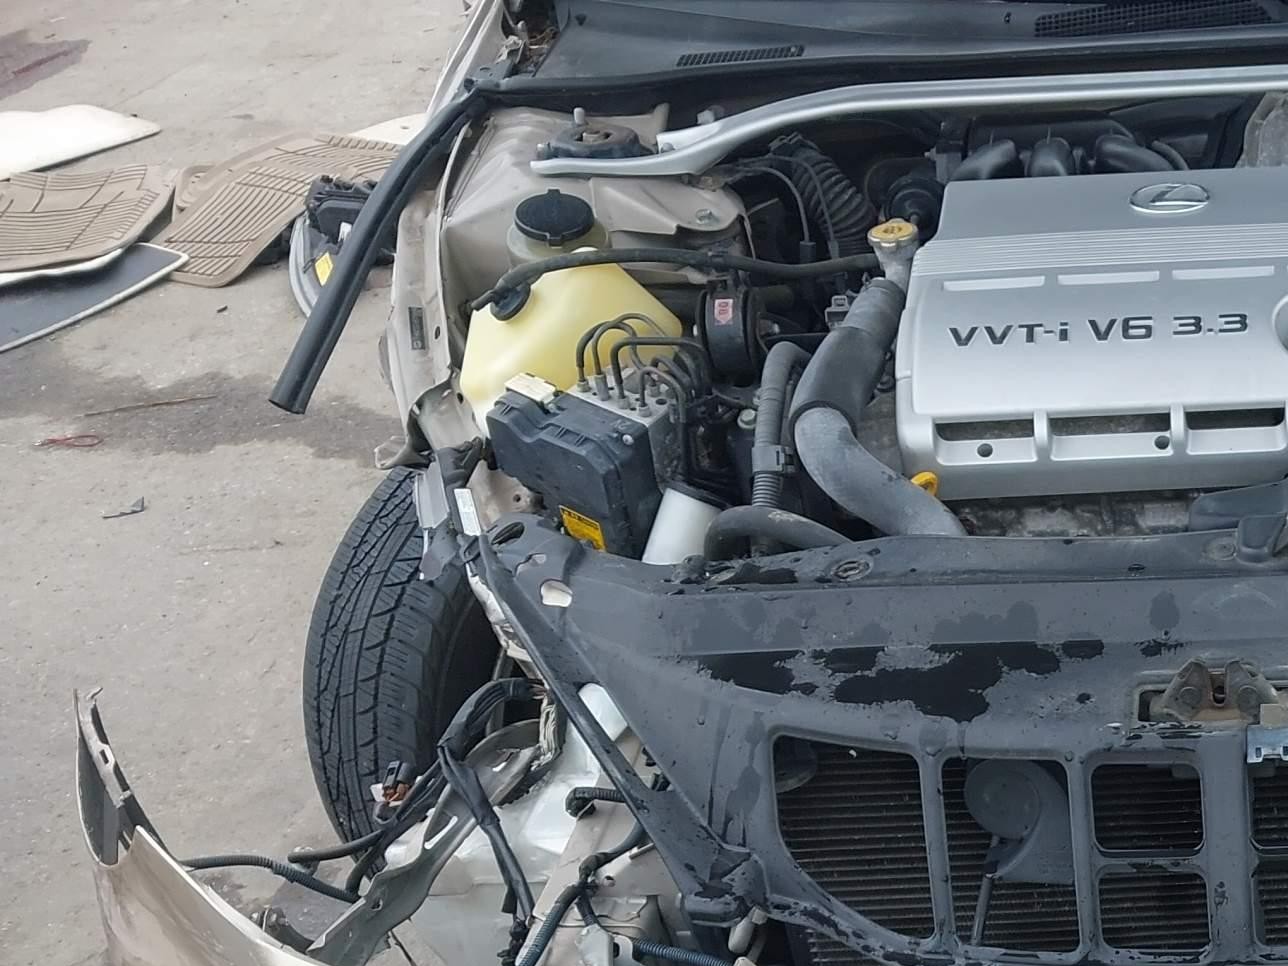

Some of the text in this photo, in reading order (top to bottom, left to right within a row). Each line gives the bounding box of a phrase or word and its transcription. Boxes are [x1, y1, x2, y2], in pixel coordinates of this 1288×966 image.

[948, 313, 1248, 347] VVT-i V6 3.3
